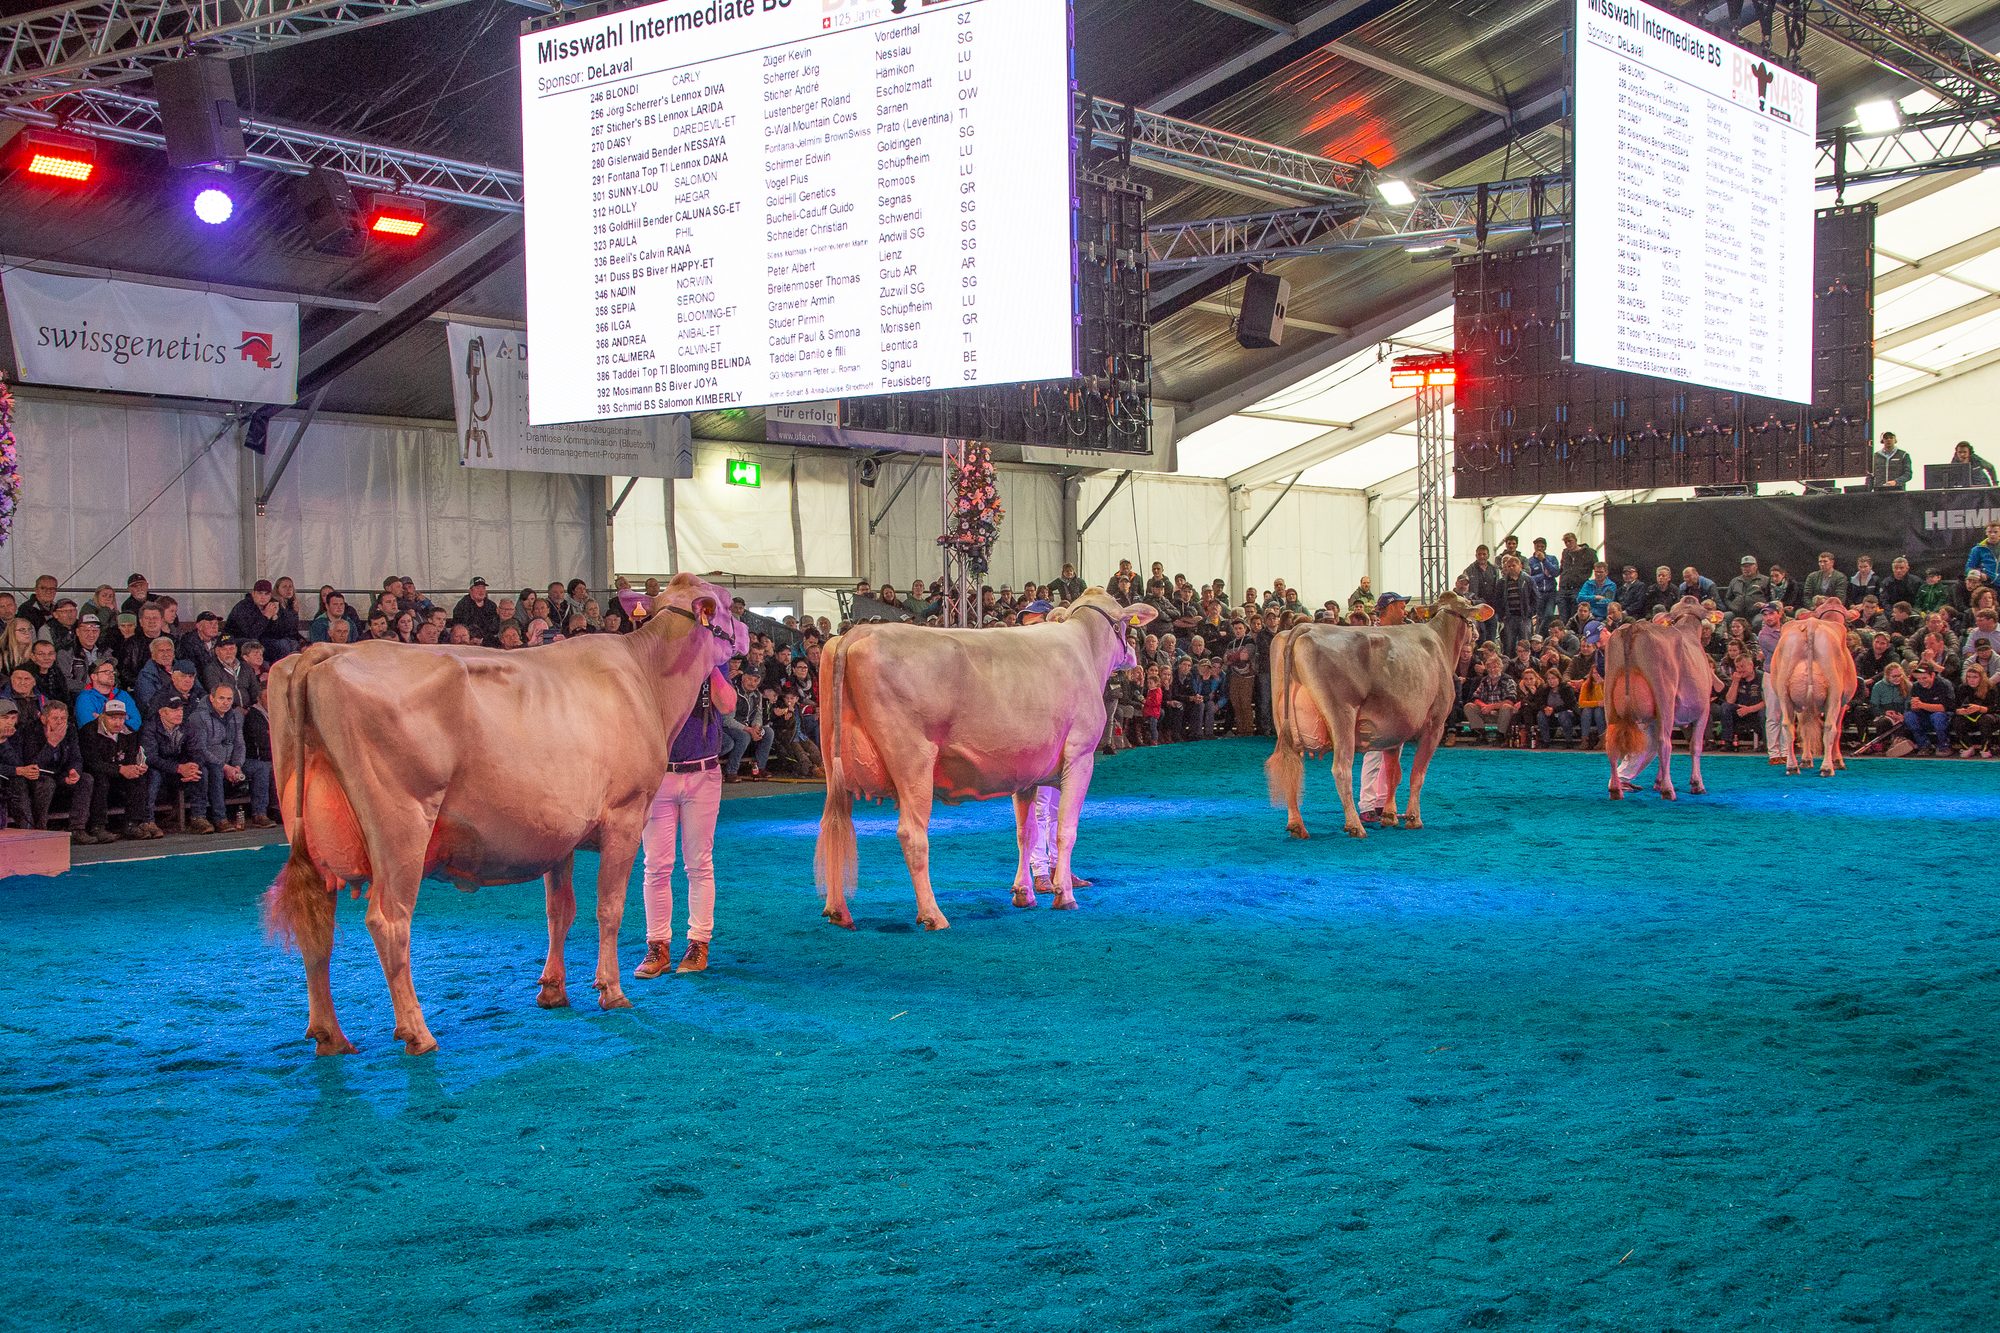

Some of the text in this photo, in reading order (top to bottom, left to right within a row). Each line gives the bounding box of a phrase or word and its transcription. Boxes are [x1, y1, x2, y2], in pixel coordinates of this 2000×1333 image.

[957, 11, 971, 25] SZ
[538, 0, 754, 64] Misswahl Intermediate
[957, 31, 973, 44] SG
[1588, 0, 1722, 68] Misswahl Intermediate BS
[1617, 35, 1645, 58] DeLaval
[958, 50, 971, 63] LU
[538, 57, 633, 92] Sponsor: DeLaval
[959, 69, 971, 82] LU
[590, 84, 639, 103] 246 BLONDI
[958, 87, 978, 101] OW
[591, 83, 725, 120] 256 Scherrer's Lennox DIVA
[591, 124, 604, 137] 267
[644, 114, 656, 126] BS
[658, 110, 689, 123] Lennox
[959, 125, 974, 138] SG
[591, 141, 605, 153] 270
[592, 135, 726, 170] 280 Bender NESSAYA
[960, 145, 972, 157] LU
[592, 152, 728, 186] 291 Fontana Top Lennox DANA
[593, 182, 658, 202] 301 SUNNY-LOU
[960, 181, 975, 194] GR
[593, 202, 637, 218] 312 HOLLY
[961, 200, 975, 213] SG
[593, 201, 741, 235] 318 Bender CALUNA SG-ET
[961, 219, 976, 232] SG
[594, 235, 637, 251] 323 PAULA
[961, 238, 976, 251] SG
[594, 256, 608, 267] 336
[667, 244, 691, 256] RANA
[961, 257, 976, 269] AR
[594, 257, 714, 284] 341 Duss BS Biver HAPPY-ET
[962, 276, 977, 288] SG
[595, 289, 608, 300] 346
[962, 295, 975, 307] LU
[611, 302, 636, 315] SEPIA
[611, 320, 631, 331] ILGA
[962, 313, 978, 325] GR
[37, 321, 226, 364] swissgenetics
[612, 334, 646, 347] ANDREA
[596, 355, 610, 365] 378
[963, 350, 977, 362] BE
[612, 368, 640, 380] Taddei
[642, 366, 658, 378] Top
[670, 363, 709, 374] Blooming
[963, 369, 977, 381] SZ
[597, 377, 718, 398] 392 Mosimann BS Biver JOYA
[597, 391, 742, 414] 393 Schmid BS Salomon KIMBERLY
[776, 405, 795, 418] Für
